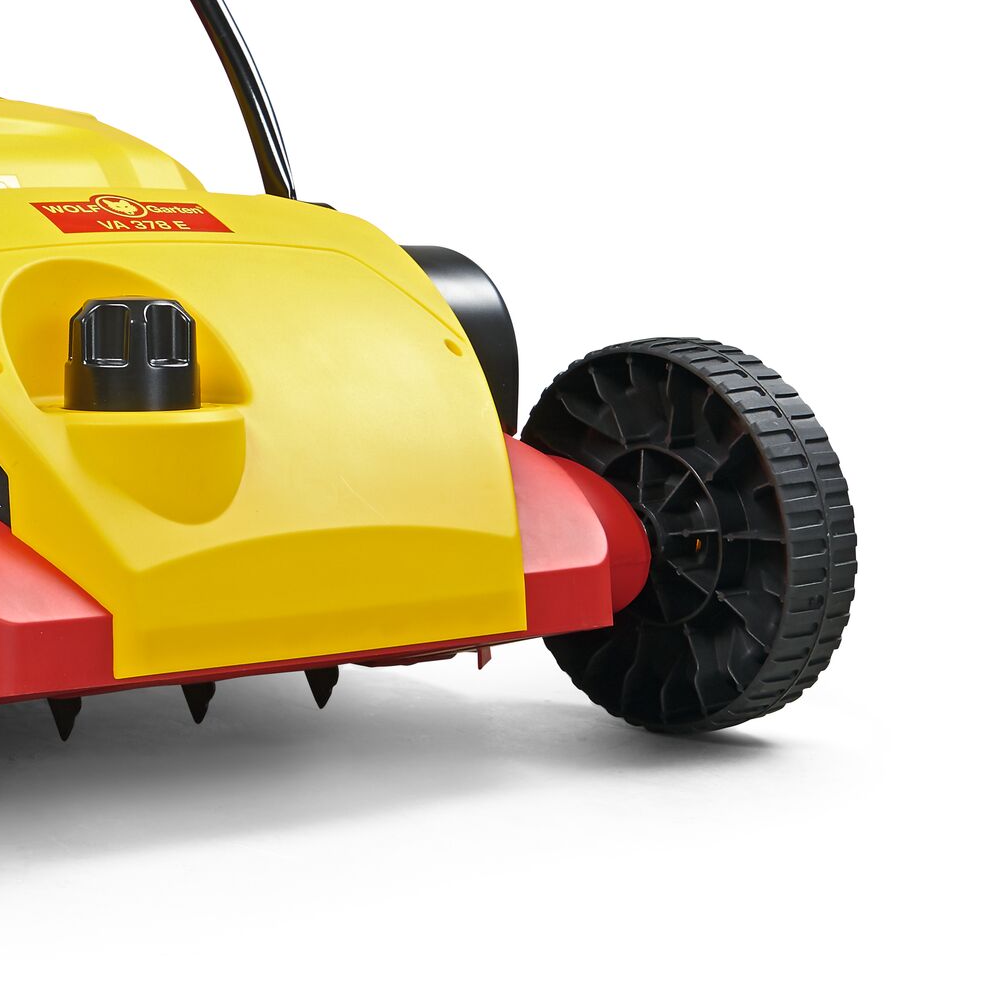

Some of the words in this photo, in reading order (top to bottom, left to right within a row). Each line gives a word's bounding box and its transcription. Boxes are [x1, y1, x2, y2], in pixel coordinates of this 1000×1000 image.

[42, 204, 101, 214] WOLF
[97, 220, 130, 230] VA
[130, 220, 172, 230] 378
[171, 220, 191, 230] E
